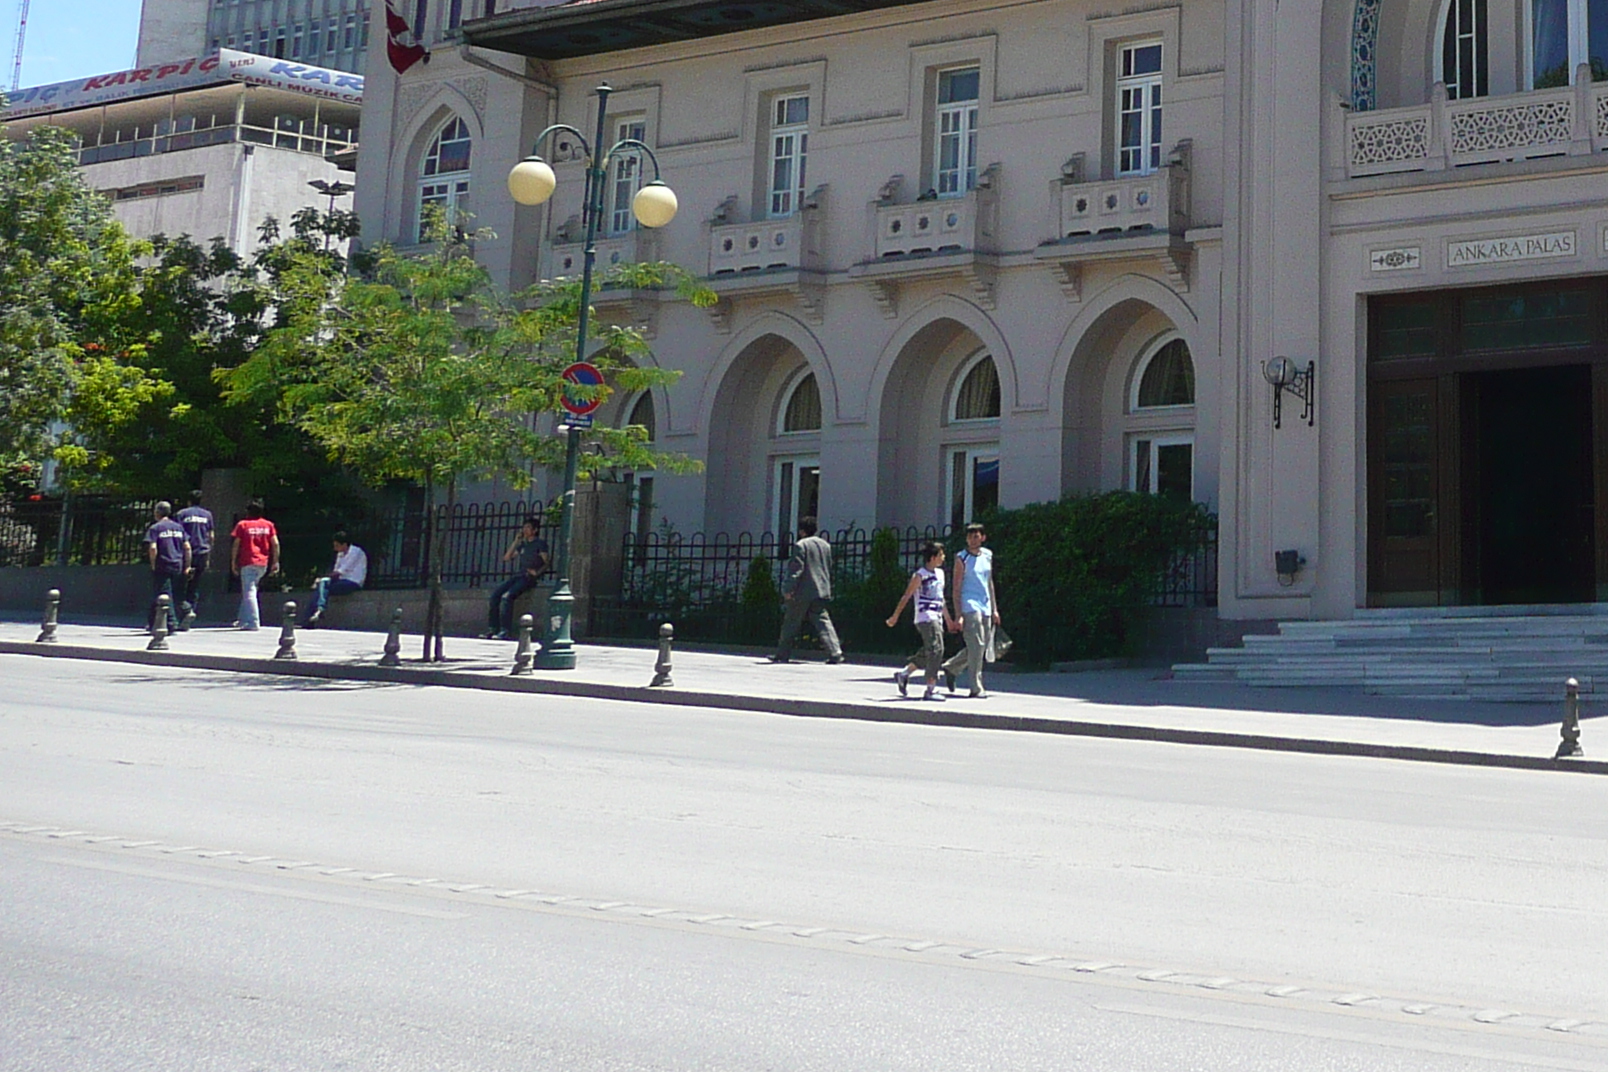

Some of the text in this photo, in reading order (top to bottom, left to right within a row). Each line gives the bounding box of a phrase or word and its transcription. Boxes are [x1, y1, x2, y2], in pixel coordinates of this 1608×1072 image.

[82, 55, 220, 92] KARPİÇ
[231, 73, 282, 87] CANLI
[1453, 236, 1571, 262] ANKARA PALAS
